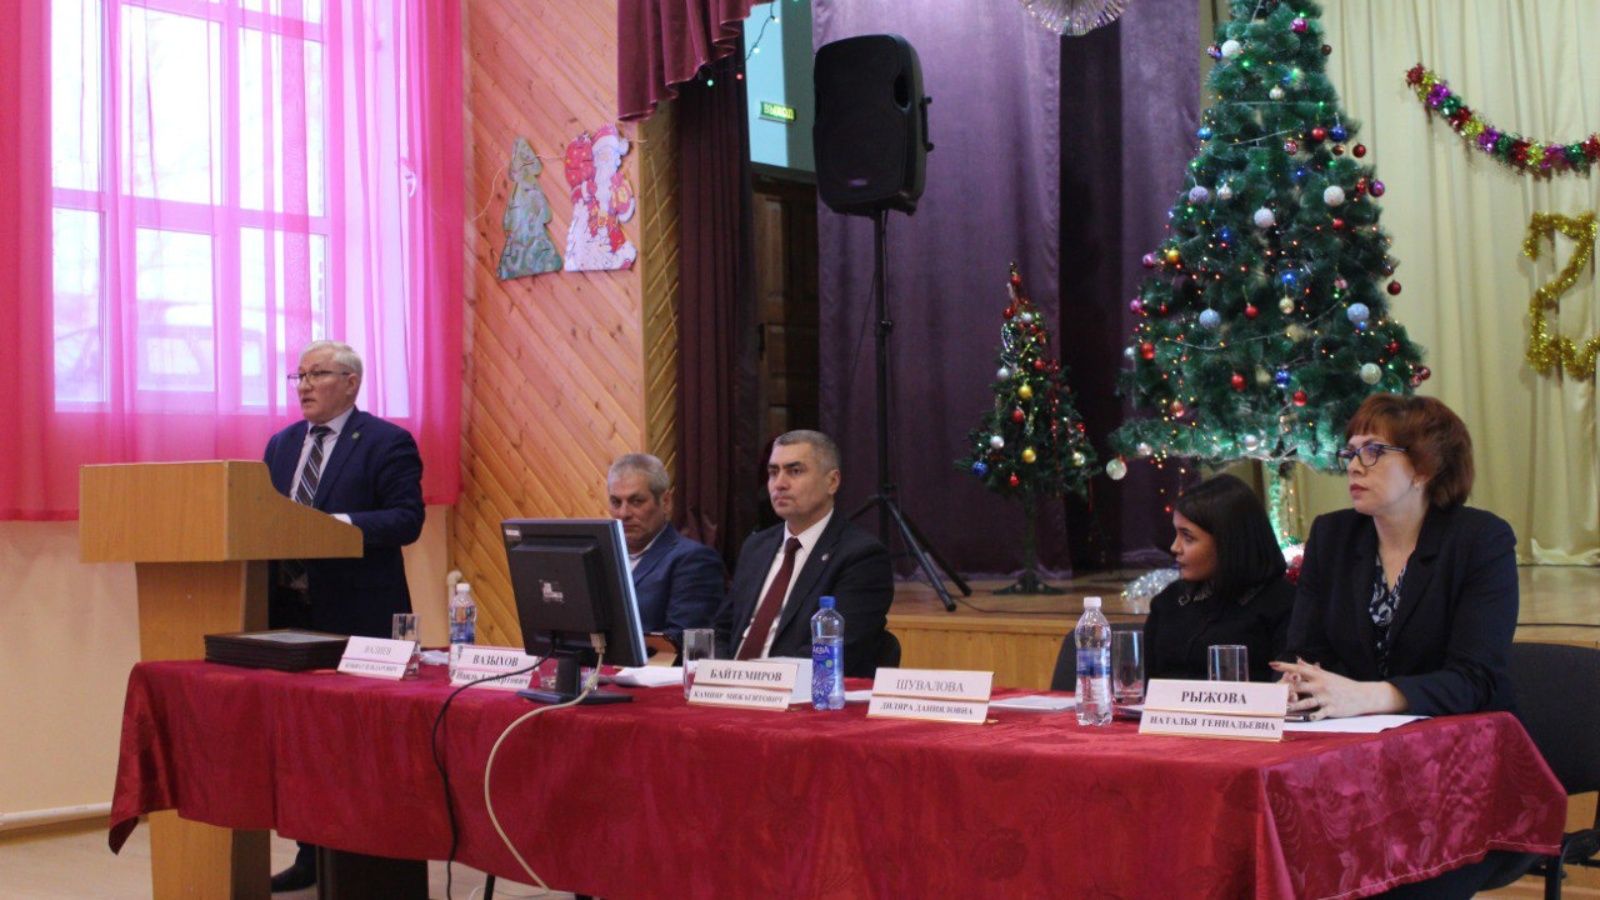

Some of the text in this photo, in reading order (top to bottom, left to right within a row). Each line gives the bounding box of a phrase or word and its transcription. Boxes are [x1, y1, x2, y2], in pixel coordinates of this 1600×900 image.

[472, 654, 519, 667] ВАЗЫХОВ
[710, 668, 783, 681] БАЙТЕМИРОВ
[896, 679, 964, 692] ШУВАЛОВА
[1181, 690, 1247, 705] РЫЖОВА
[1150, 715, 1276, 731] НАТАЛЬЯ ГЕННАДЬЕВНА
